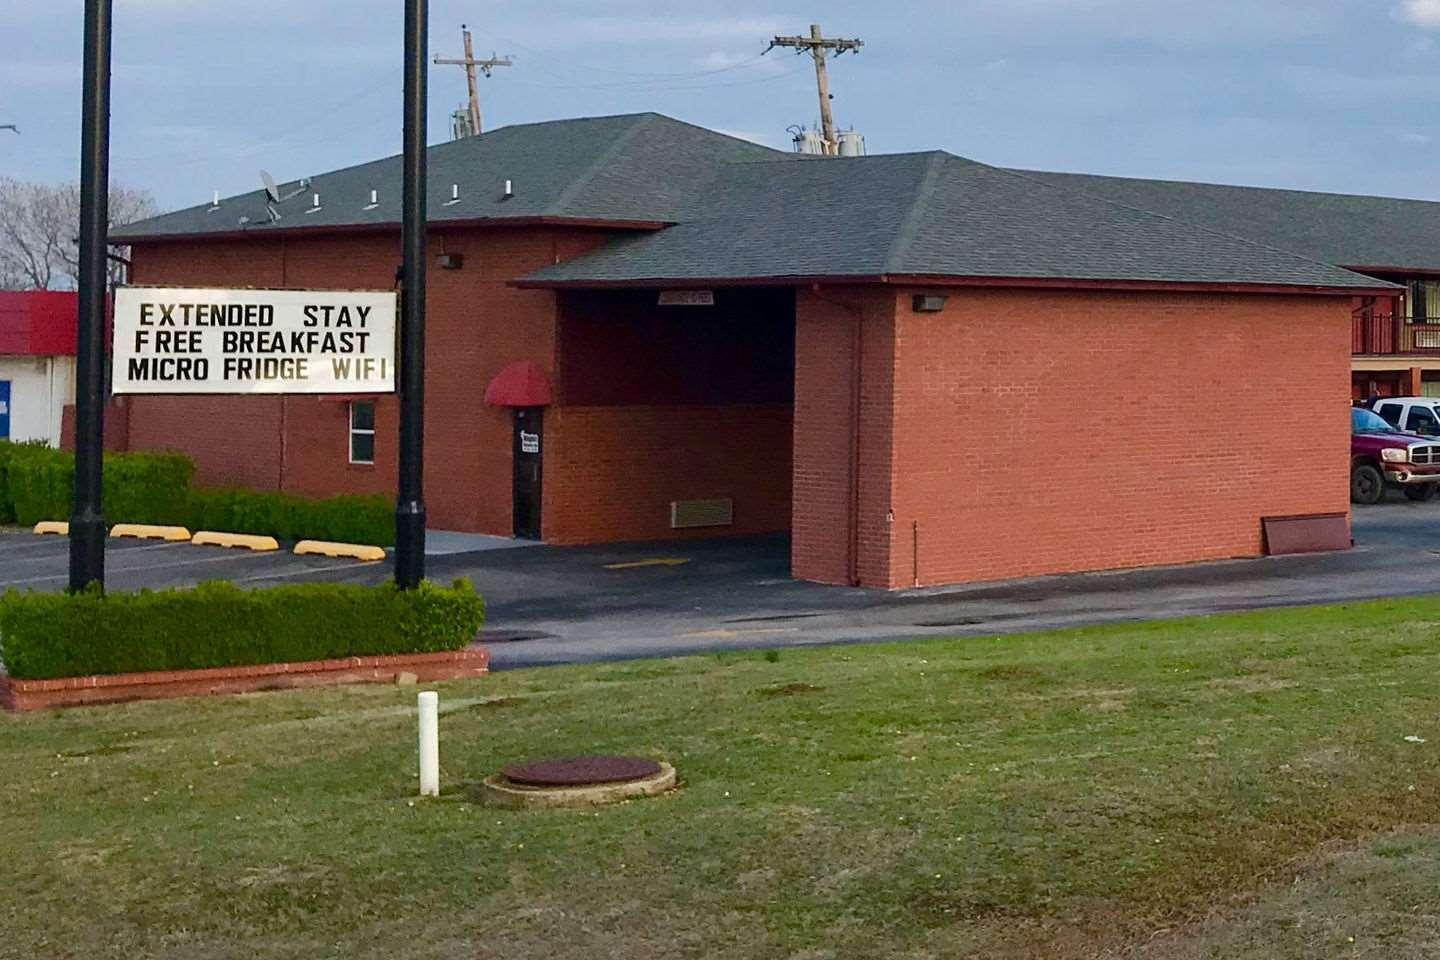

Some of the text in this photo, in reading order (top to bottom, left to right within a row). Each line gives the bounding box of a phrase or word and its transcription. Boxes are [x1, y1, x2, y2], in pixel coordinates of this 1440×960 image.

[140, 303, 371, 328] EXTENDED STAY
[135, 330, 371, 354] FREE BREAKFAST
[128, 357, 387, 381] MICRO FRIDGE WIFI
